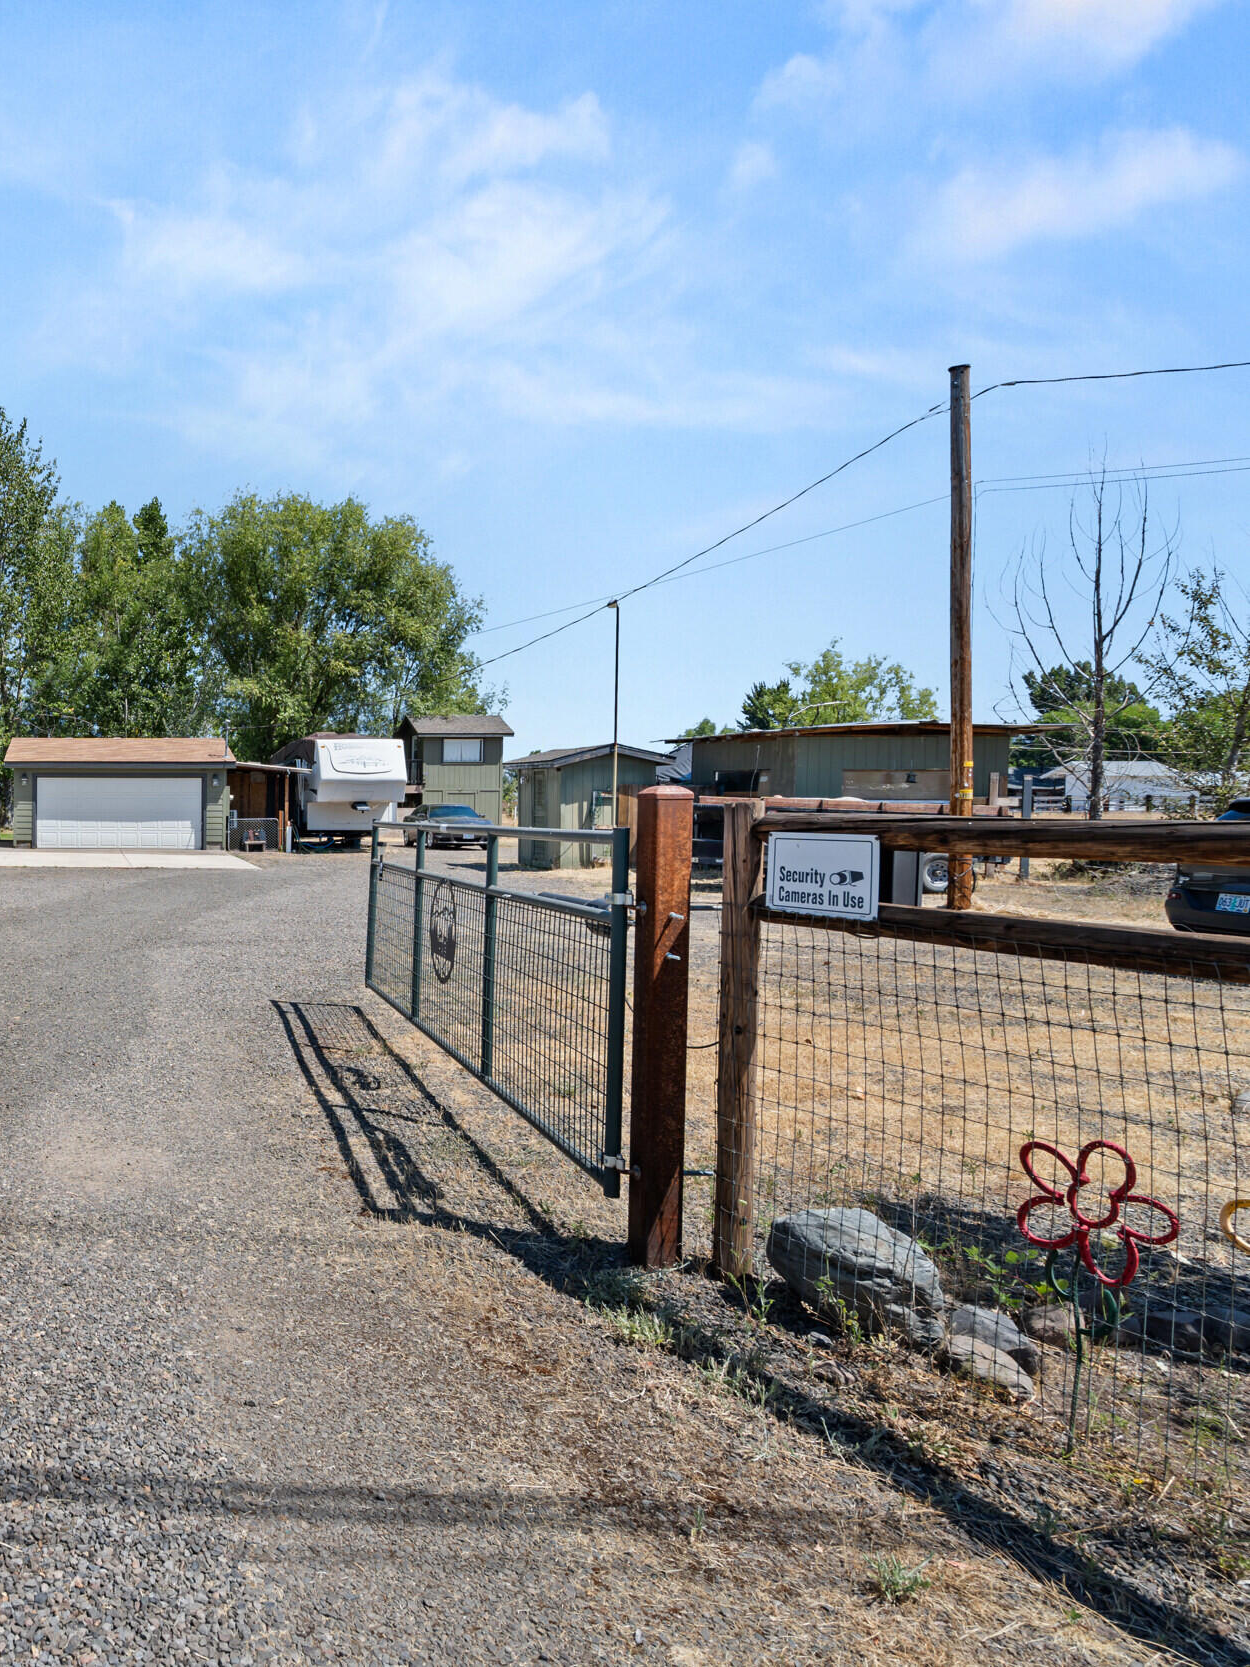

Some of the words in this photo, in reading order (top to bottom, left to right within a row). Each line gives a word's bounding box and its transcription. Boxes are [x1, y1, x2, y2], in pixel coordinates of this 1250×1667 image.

[779, 866, 825, 887] Security
[778, 886, 824, 905] Cameras
[828, 890, 838, 906] In
[843, 891, 864, 909] Use
